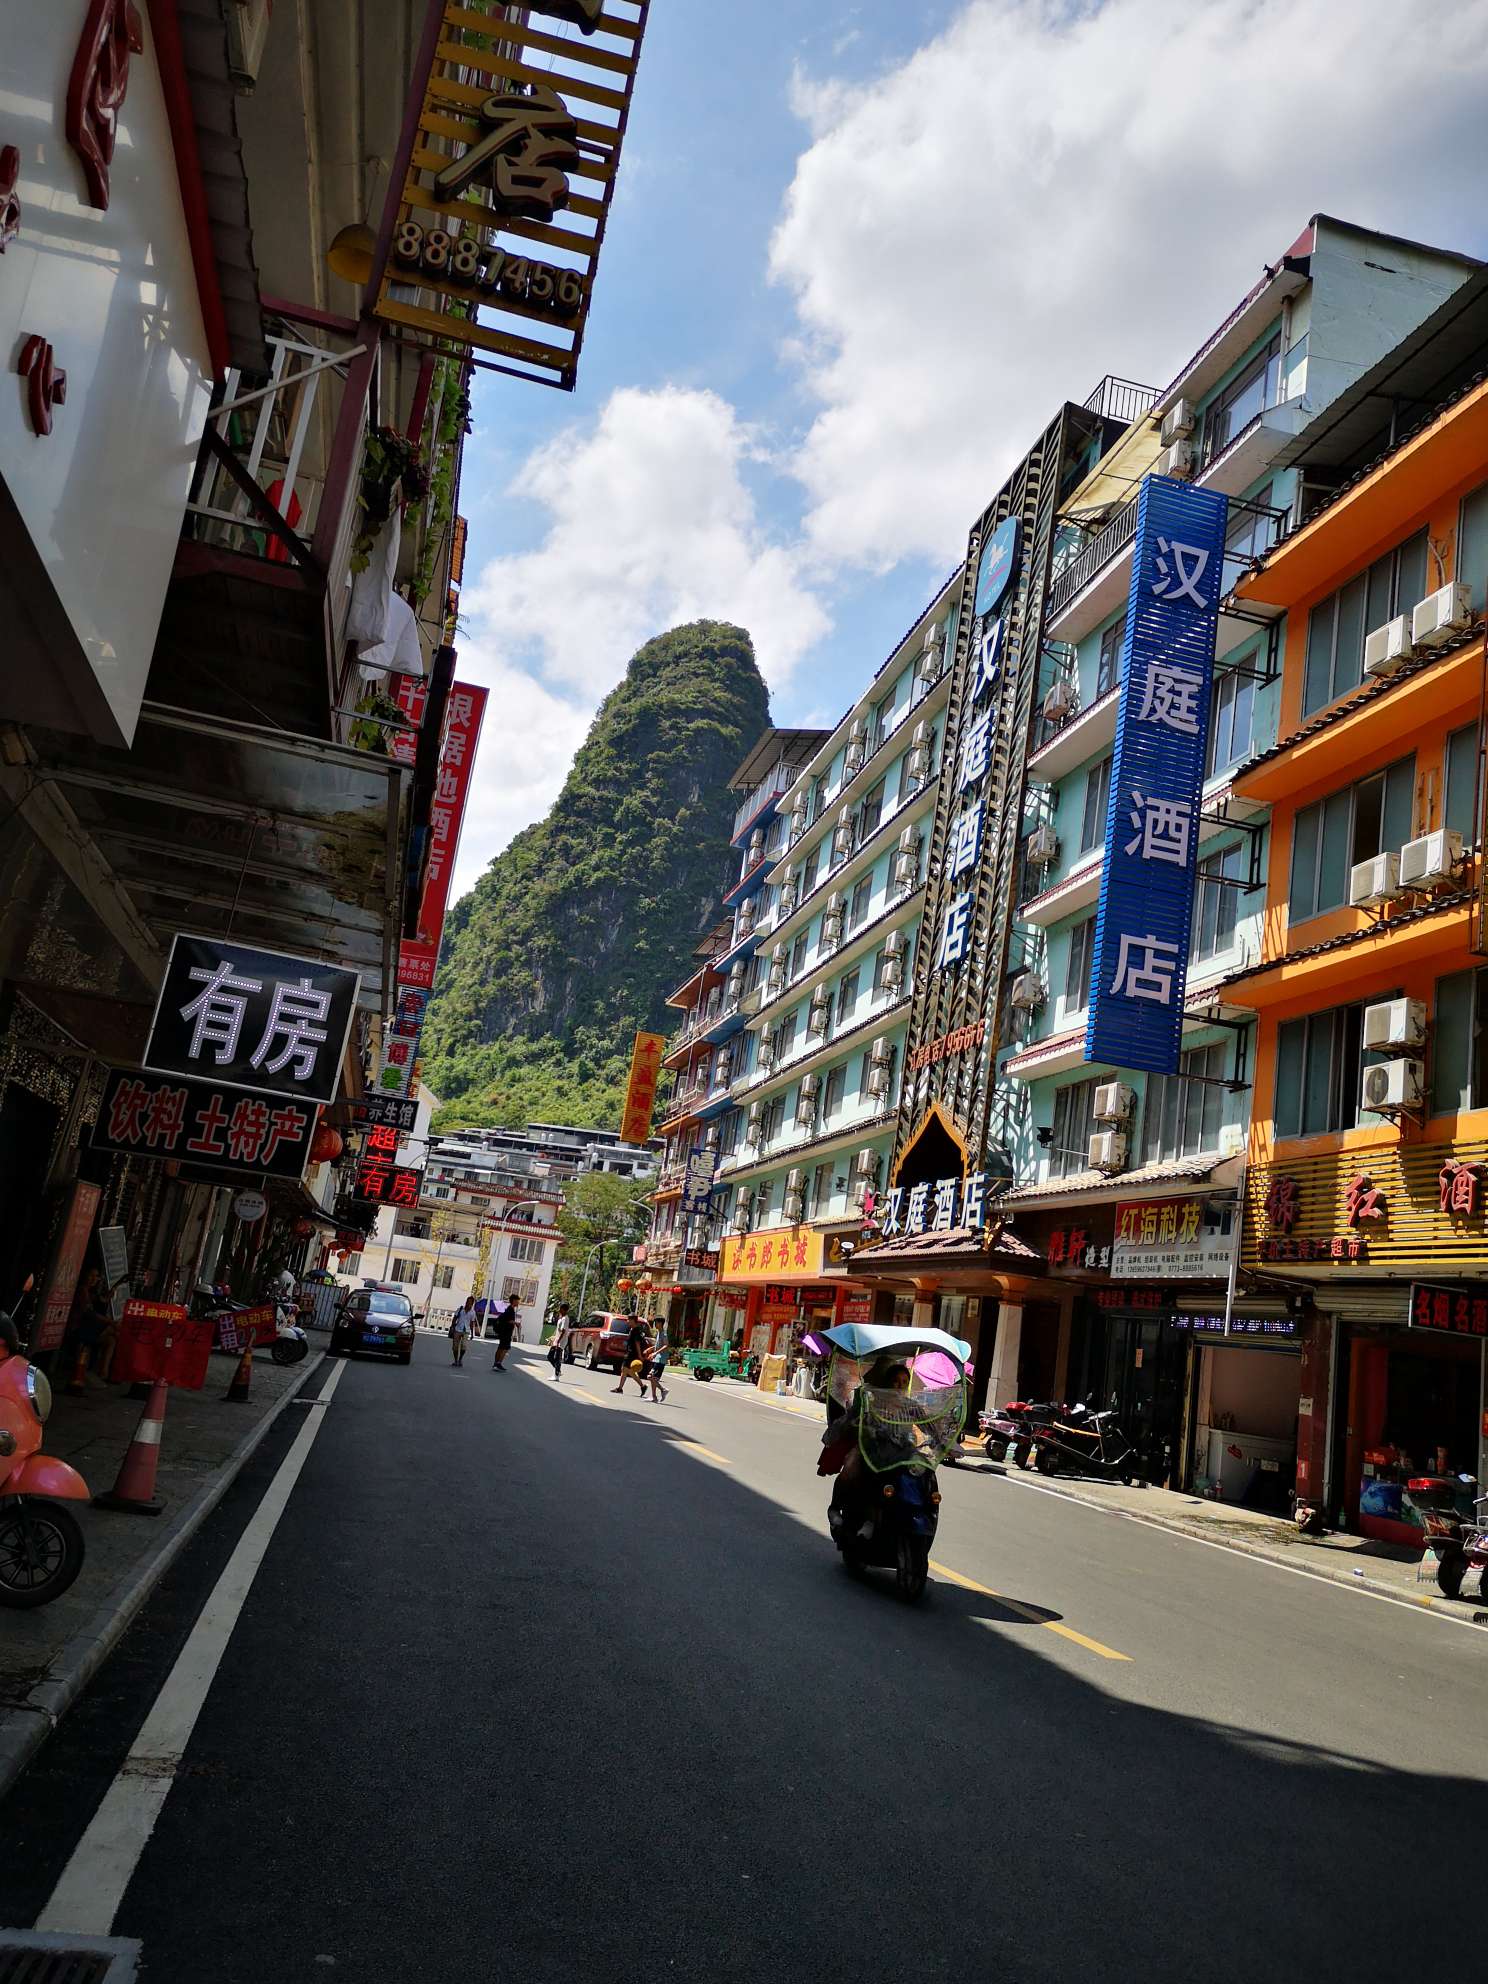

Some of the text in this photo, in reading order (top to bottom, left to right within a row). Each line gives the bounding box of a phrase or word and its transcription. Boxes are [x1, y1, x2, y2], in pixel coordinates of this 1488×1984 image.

[394, 221, 581, 309] 8887456
[1110, 536, 1208, 1005] 汉庭酒店
[936, 618, 1005, 970] 汉庭酒店
[179, 960, 333, 1081] 有房
[107, 1078, 308, 1166] 饮料 土特产
[361, 1167, 417, 1203] 有房
[882, 1170, 989, 1236] 汉庭酒店
[1119, 1203, 1200, 1247] 红海科技
[686, 1251, 717, 1268] 书城
[1085, 1245, 1112, 1269] 造型
[146, 1308, 183, 1321] 电动车
[219, 1315, 240, 1350] 出租
[236, 1309, 274, 1328] 电动车
